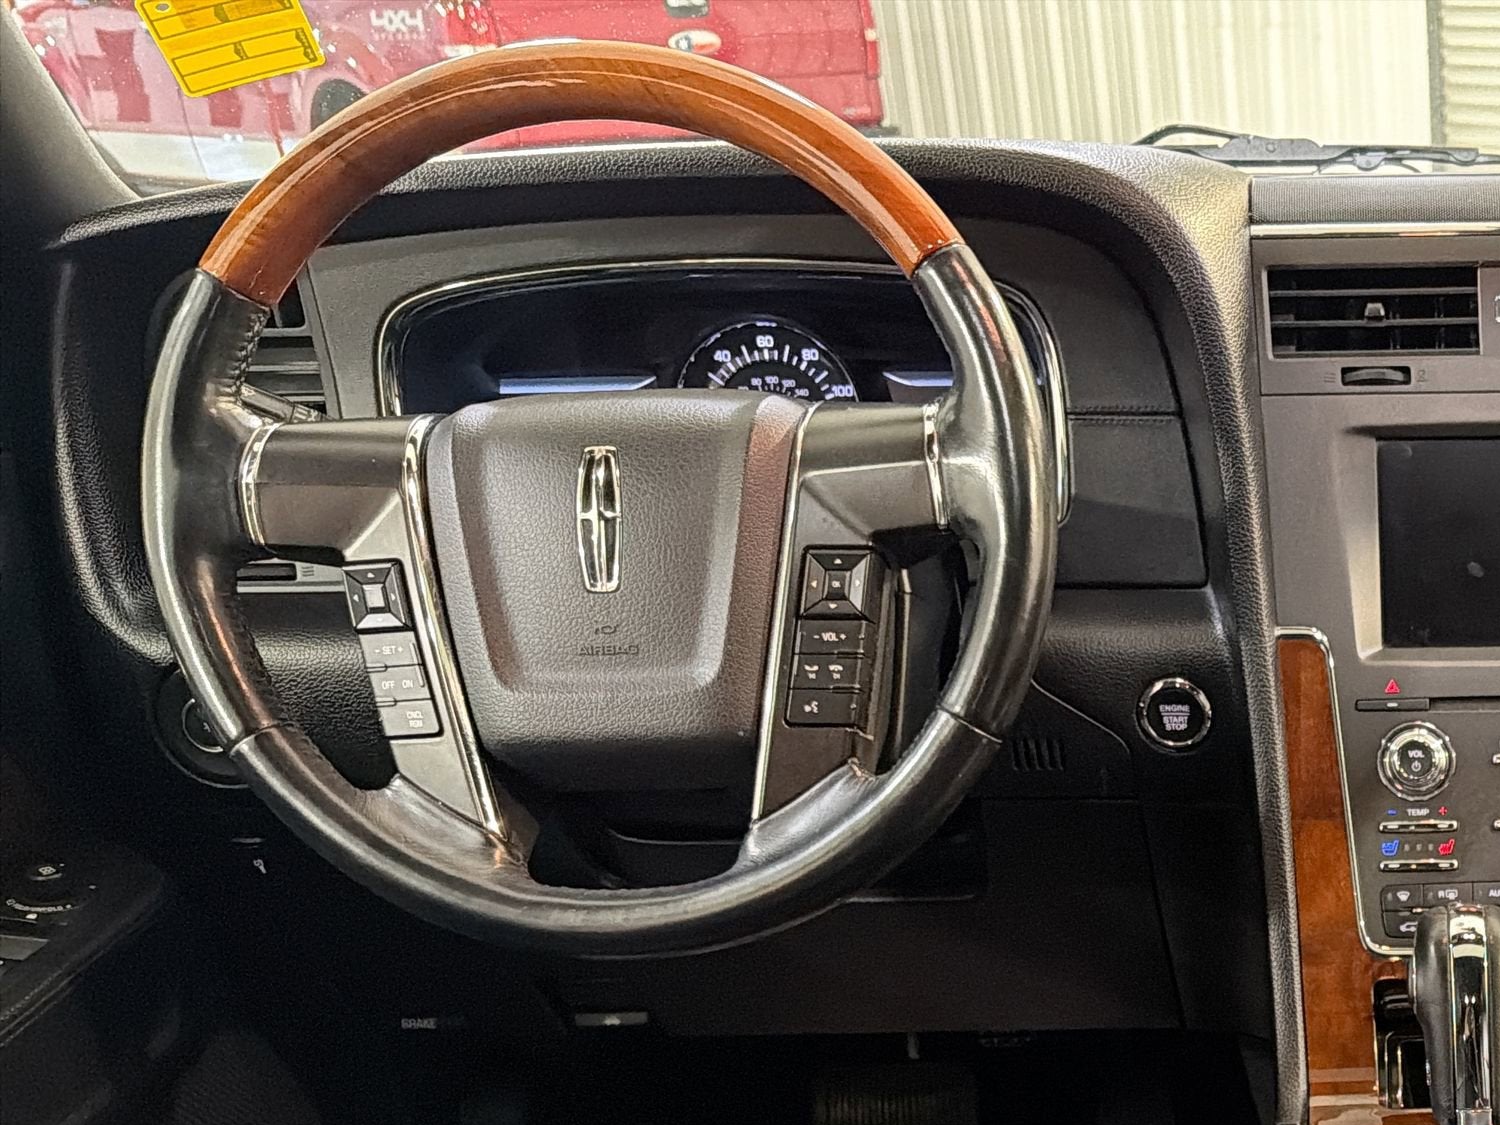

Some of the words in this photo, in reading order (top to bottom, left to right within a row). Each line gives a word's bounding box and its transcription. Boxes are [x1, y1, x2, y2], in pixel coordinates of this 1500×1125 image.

[755, 335, 774, 348] 60
[713, 350, 731, 363] 40
[801, 349, 819, 361] 80
[765, 376, 779, 385] 100
[782, 379, 796, 388] 120
[832, 385, 853, 397] 100
[821, 632, 839, 642] VOL
[382, 646, 396, 655] SET
[381, 680, 395, 690] OFF
[402, 679, 413, 689] ON
[1159, 704, 1190, 713] ENGINE
[1162, 716, 1188, 724] START
[1165, 723, 1188, 731] STOP
[1407, 750, 1425, 758] VOL
[1406, 808, 1430, 816] TEMP
